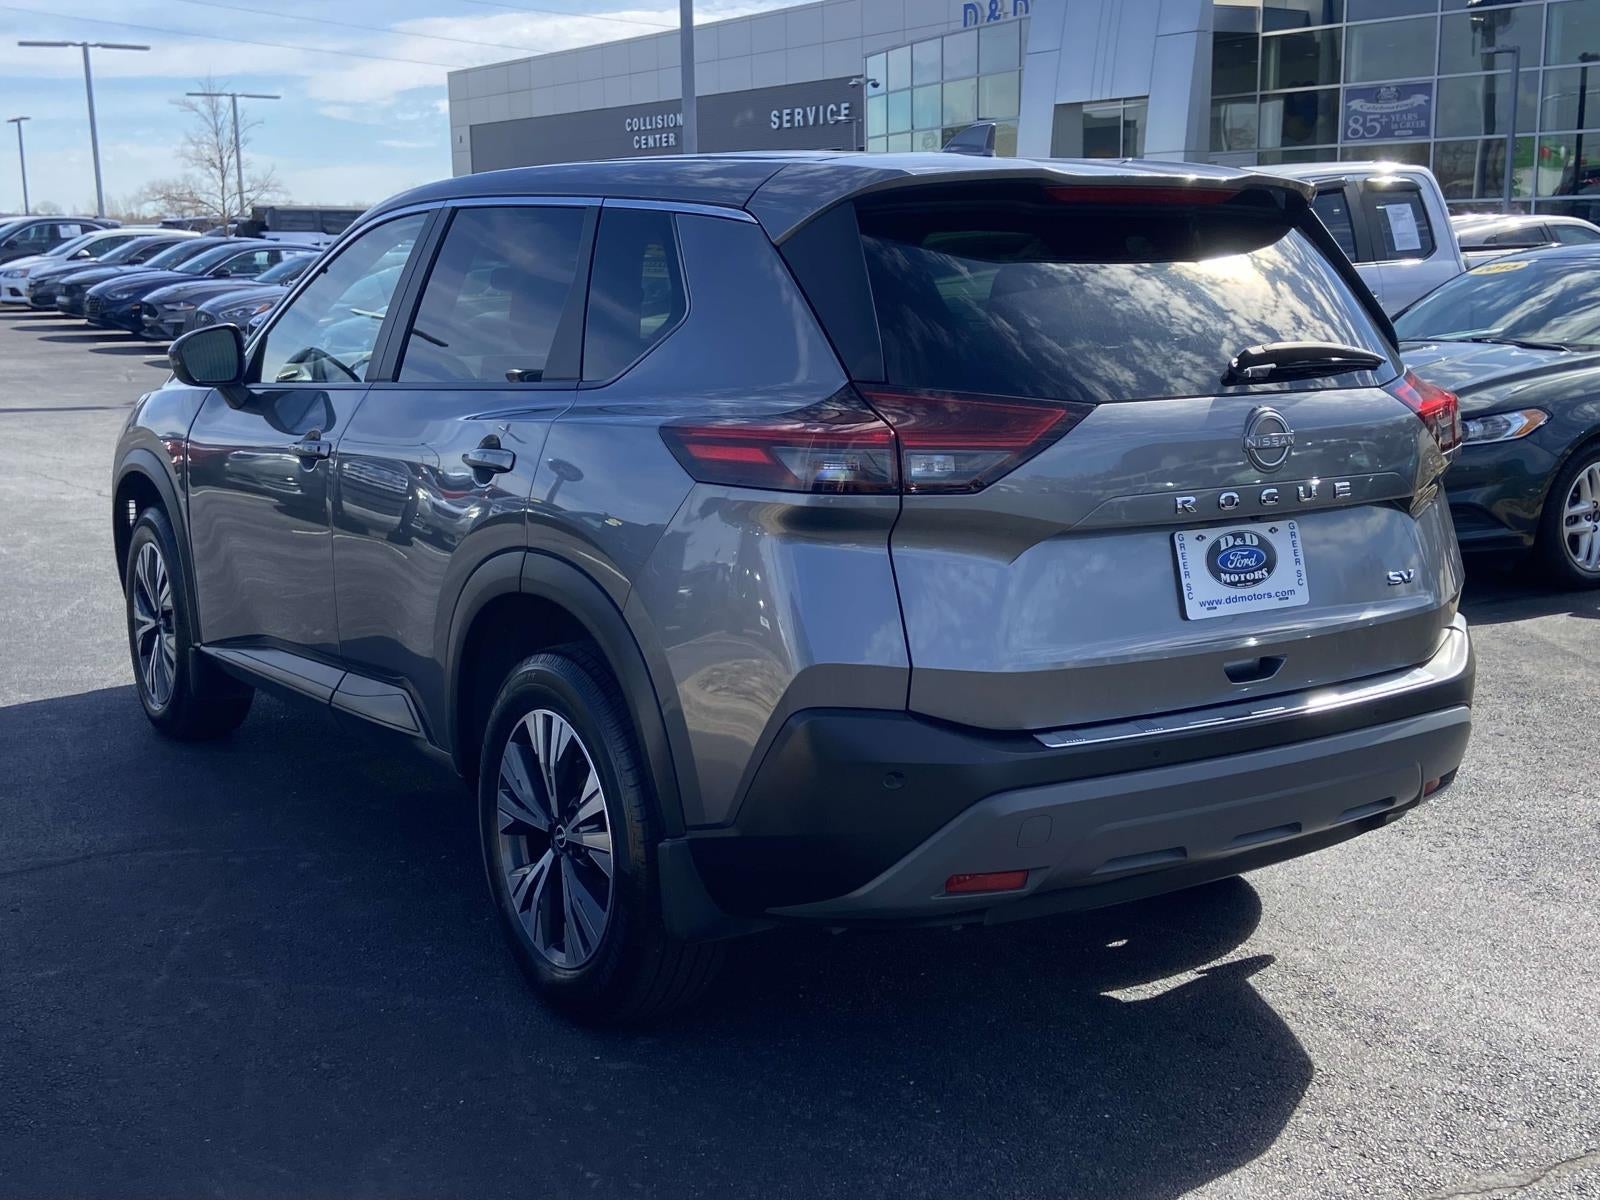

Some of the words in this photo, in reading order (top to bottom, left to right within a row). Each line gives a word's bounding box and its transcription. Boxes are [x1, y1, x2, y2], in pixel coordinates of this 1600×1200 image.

[625, 112, 683, 132] COLLISION
[770, 102, 850, 130] SERVICE
[633, 132, 676, 149] CENTER
[1247, 435, 1295, 447] NISSAN
[1175, 481, 1351, 514] ROGUE
[1220, 532, 1259, 551] D&D
[1228, 551, 1257, 569] Ford
[1220, 567, 1268, 583] MOTORS
[1387, 568, 1415, 585] SV
[1199, 588, 1296, 607] www.ddmotors.com
